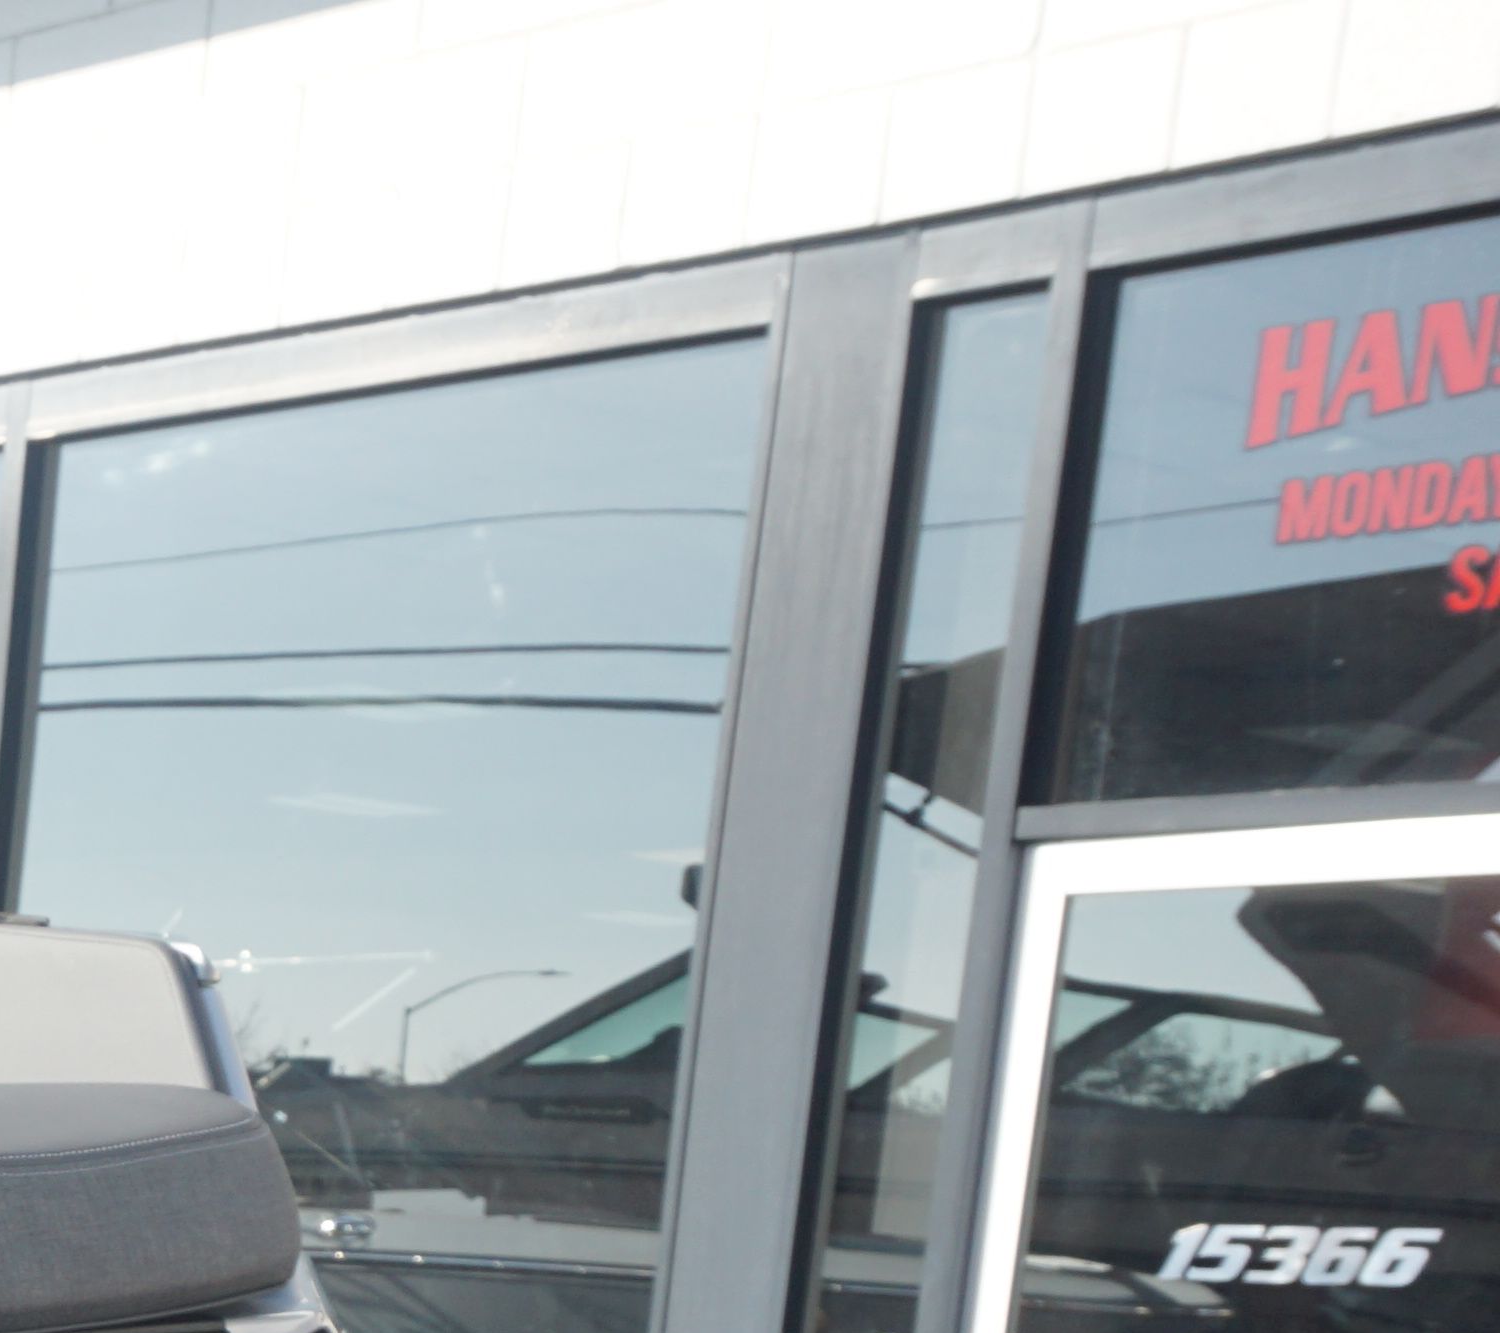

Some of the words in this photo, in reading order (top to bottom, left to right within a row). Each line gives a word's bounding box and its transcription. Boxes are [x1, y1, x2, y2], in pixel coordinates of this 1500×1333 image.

[1244, 293, 1500, 450] HAN
[1444, 543, 1500, 613] S
[1155, 1222, 1443, 1287] 15366
